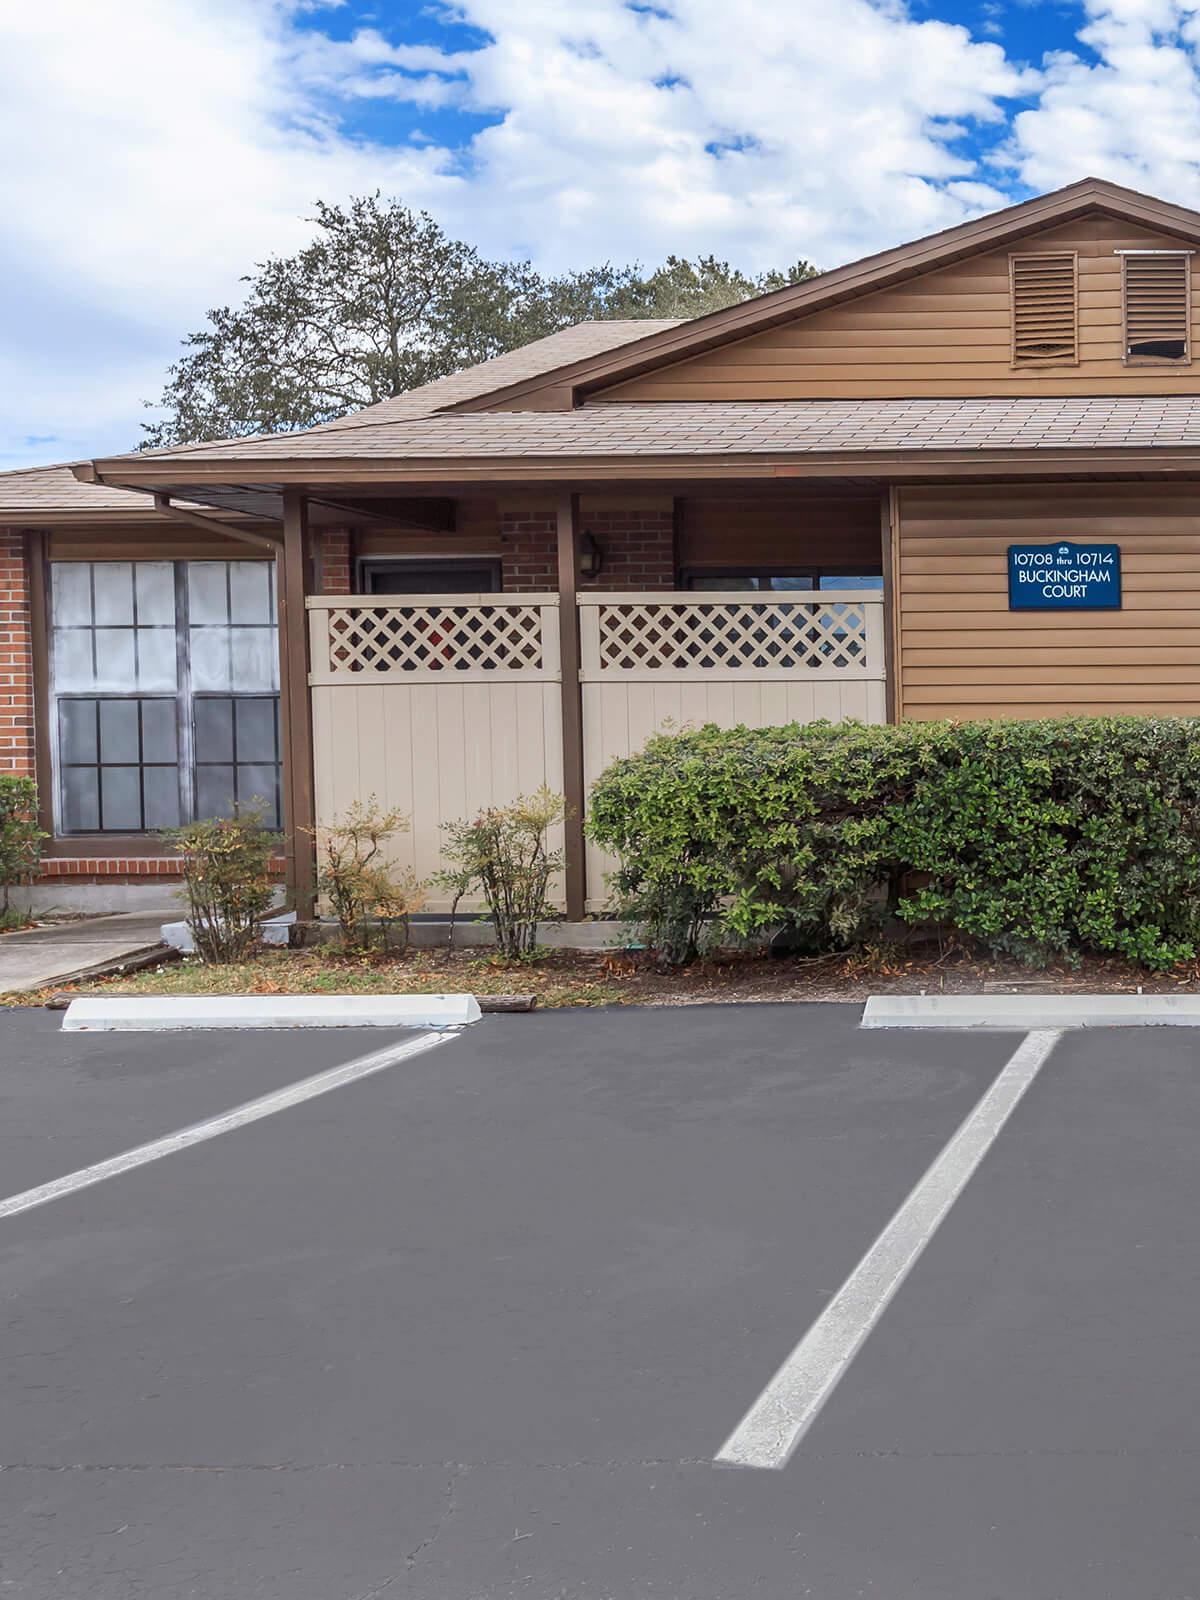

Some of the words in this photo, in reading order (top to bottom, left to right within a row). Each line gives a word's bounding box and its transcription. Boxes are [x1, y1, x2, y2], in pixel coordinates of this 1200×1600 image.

[1014, 553, 1053, 566] 10708
[1056, 557, 1072, 565] thru
[1076, 553, 1114, 566] 10714
[1019, 569, 1111, 583] BUCKINGHAM
[1042, 585, 1088, 598] COURT
